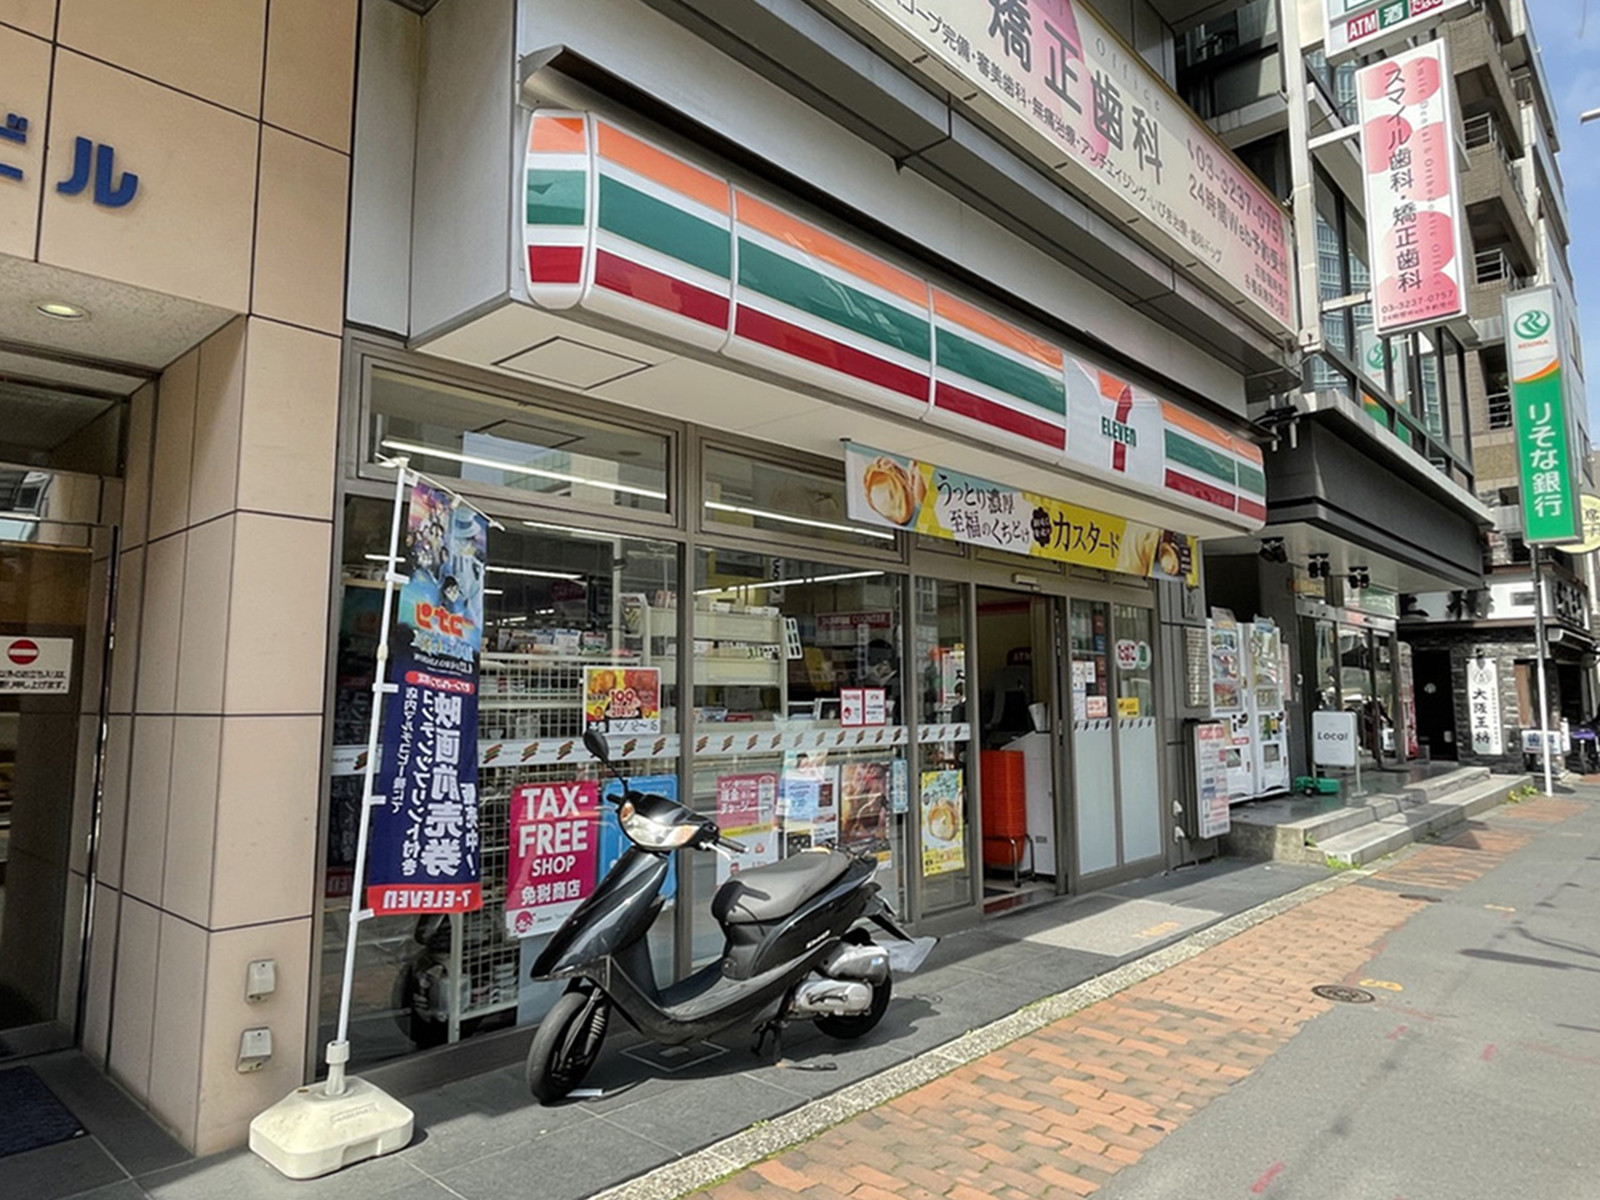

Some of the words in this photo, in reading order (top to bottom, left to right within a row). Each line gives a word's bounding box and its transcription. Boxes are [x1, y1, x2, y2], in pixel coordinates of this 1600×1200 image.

[1348, 13, 1378, 39] ATM
[1383, 2, 1404, 26] 酒
[1384, 66, 1423, 293] スマイル歯科・矯正歯科
[1381, 289, 1454, 314] 03-3237-0757
[1528, 402, 1563, 518] りそな銀行
[937, 473, 1015, 514] うっとり濃厚
[950, 508, 1030, 545] 至福のくちどけ
[1053, 511, 1120, 558] カスタード
[1317, 730, 1349, 742] Local
[521, 786, 589, 821] TAX-
[518, 820, 589, 858] FREE
[531, 855, 576, 877] SHOP
